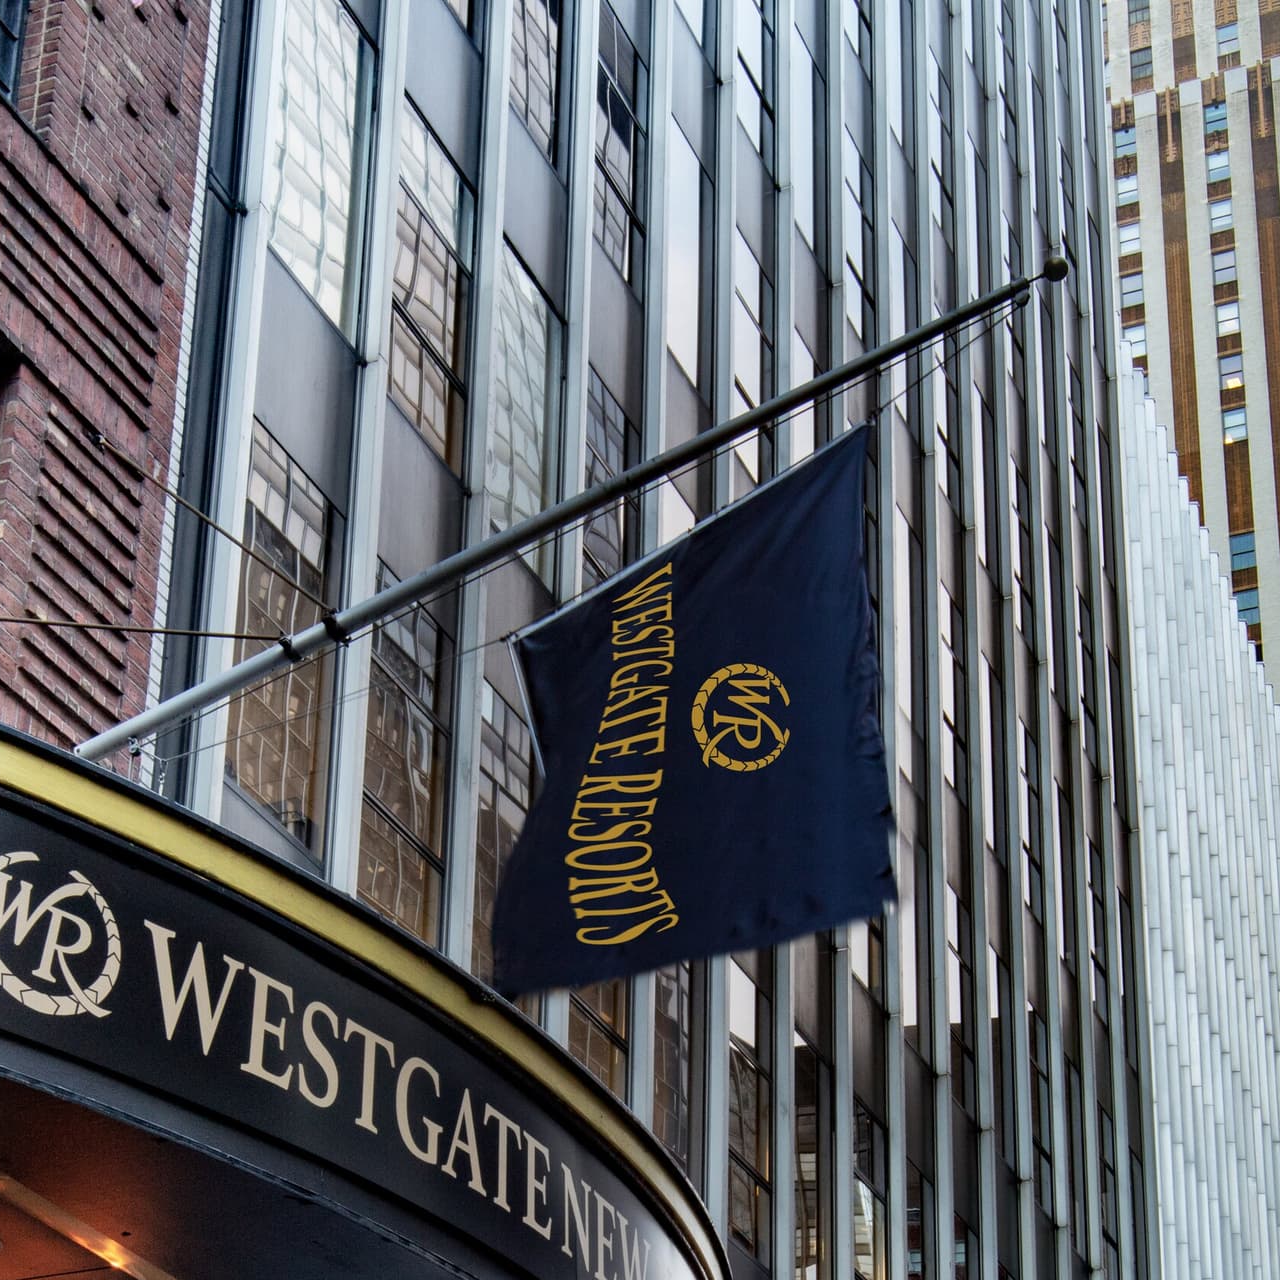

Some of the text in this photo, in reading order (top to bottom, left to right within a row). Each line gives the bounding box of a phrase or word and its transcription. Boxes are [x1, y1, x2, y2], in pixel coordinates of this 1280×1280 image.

[565, 562, 679, 946] WESTGATE RESORTS
[701, 676, 786, 769] WR
[144, 919, 553, 1241] WESTGATE
